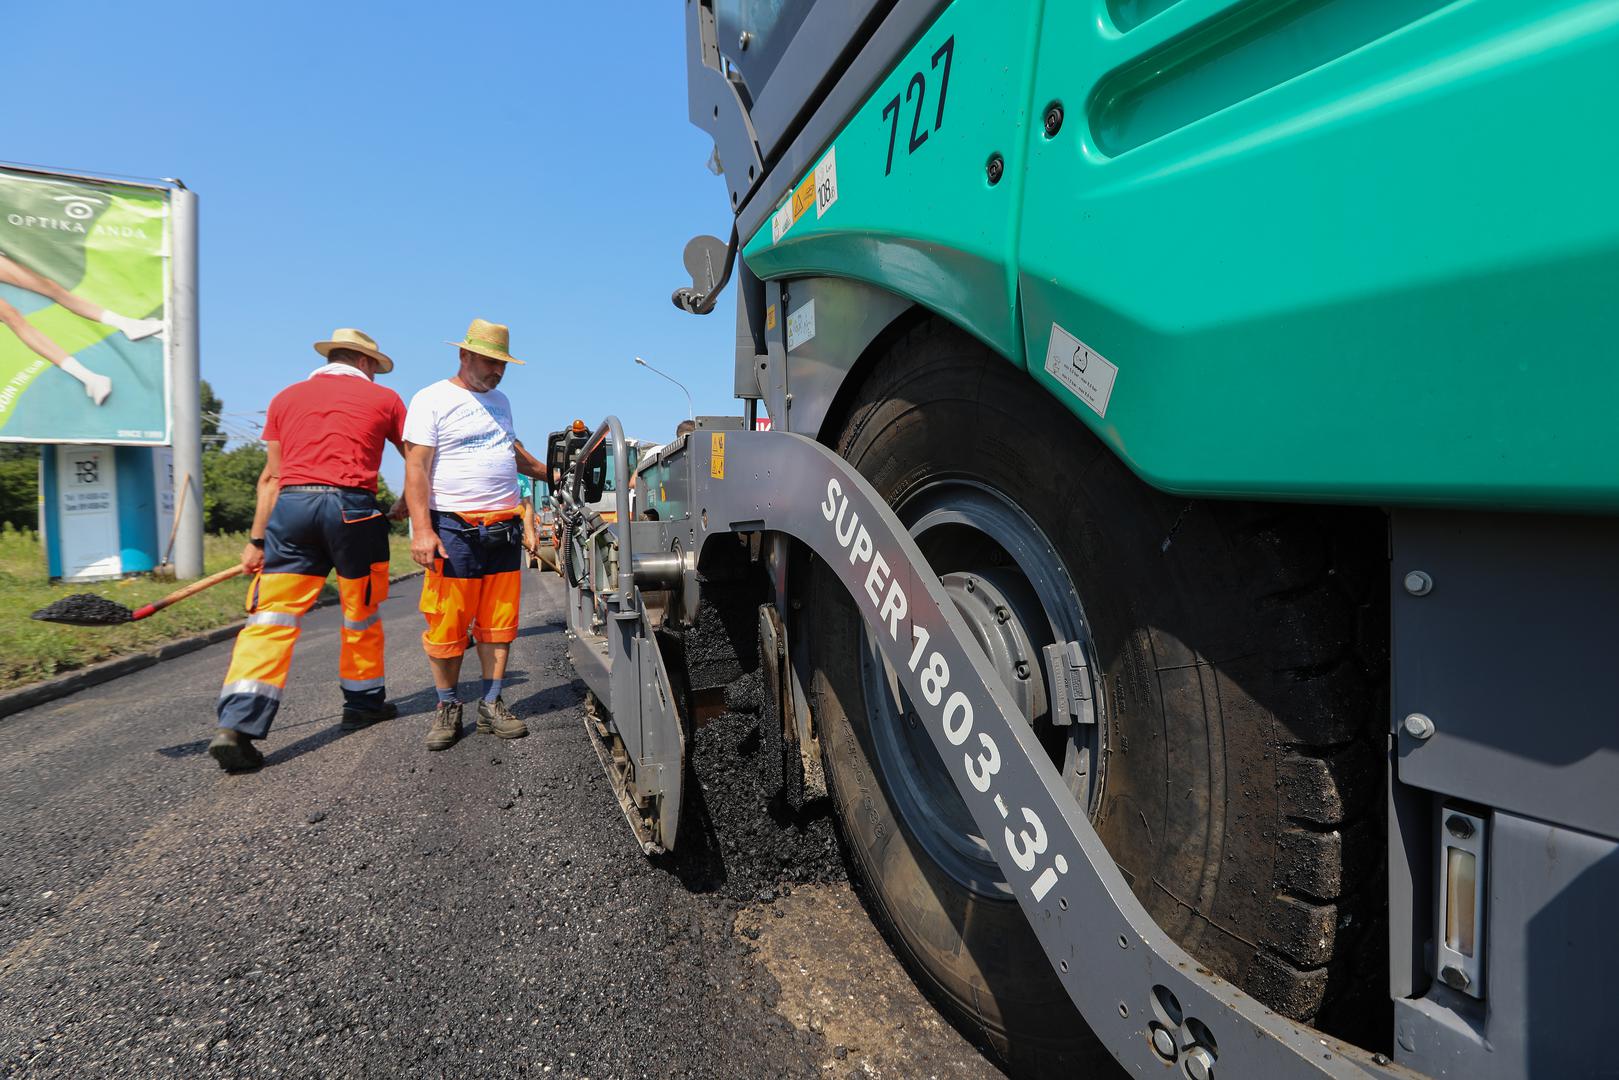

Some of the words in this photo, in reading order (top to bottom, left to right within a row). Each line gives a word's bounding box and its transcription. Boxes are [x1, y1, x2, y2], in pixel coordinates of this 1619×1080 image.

[882, 34, 955, 177] 727
[7, 213, 87, 234] OPTIKA
[94, 224, 147, 240] ANDA
[817, 178, 831, 210] 108
[821, 478, 908, 641] SUPER
[907, 624, 1069, 903] 1803-3i
